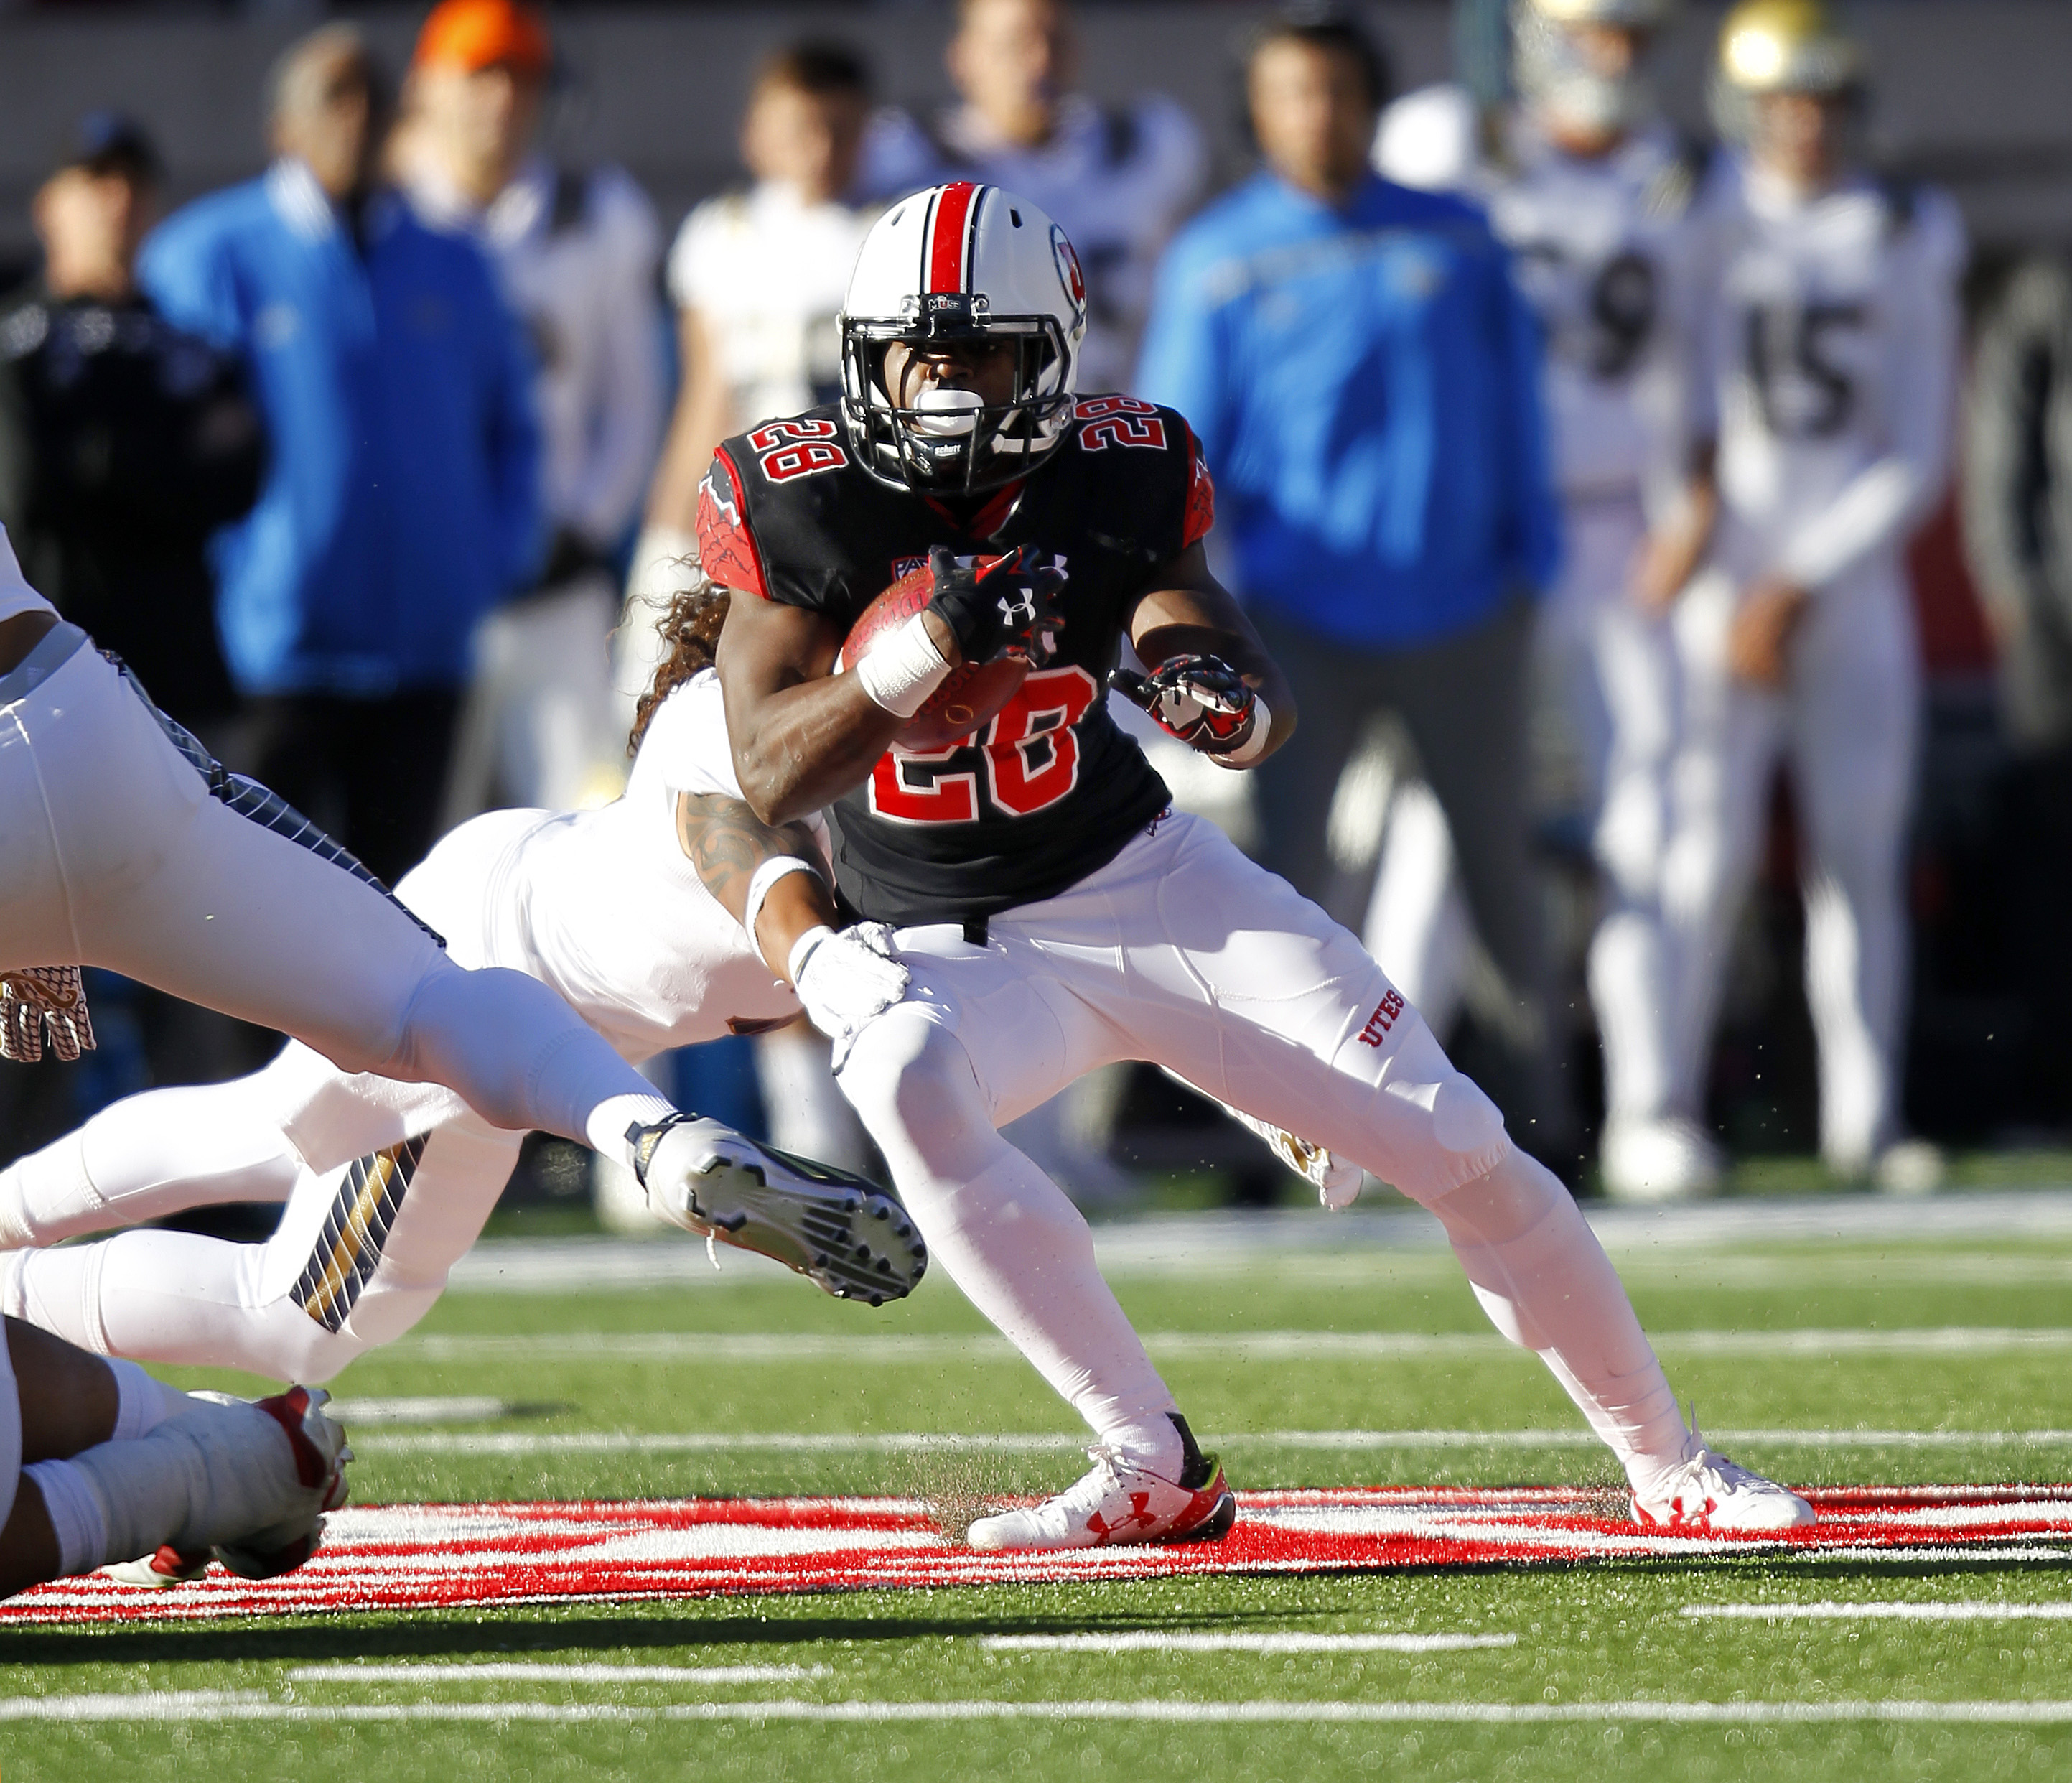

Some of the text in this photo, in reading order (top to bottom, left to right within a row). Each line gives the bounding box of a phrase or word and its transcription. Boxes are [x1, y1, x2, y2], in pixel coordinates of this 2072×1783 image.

[747, 419, 849, 484] 28
[1073, 396, 1167, 451] 28
[867, 664, 1098, 824] 28
[1358, 989, 1404, 1048] UTES
